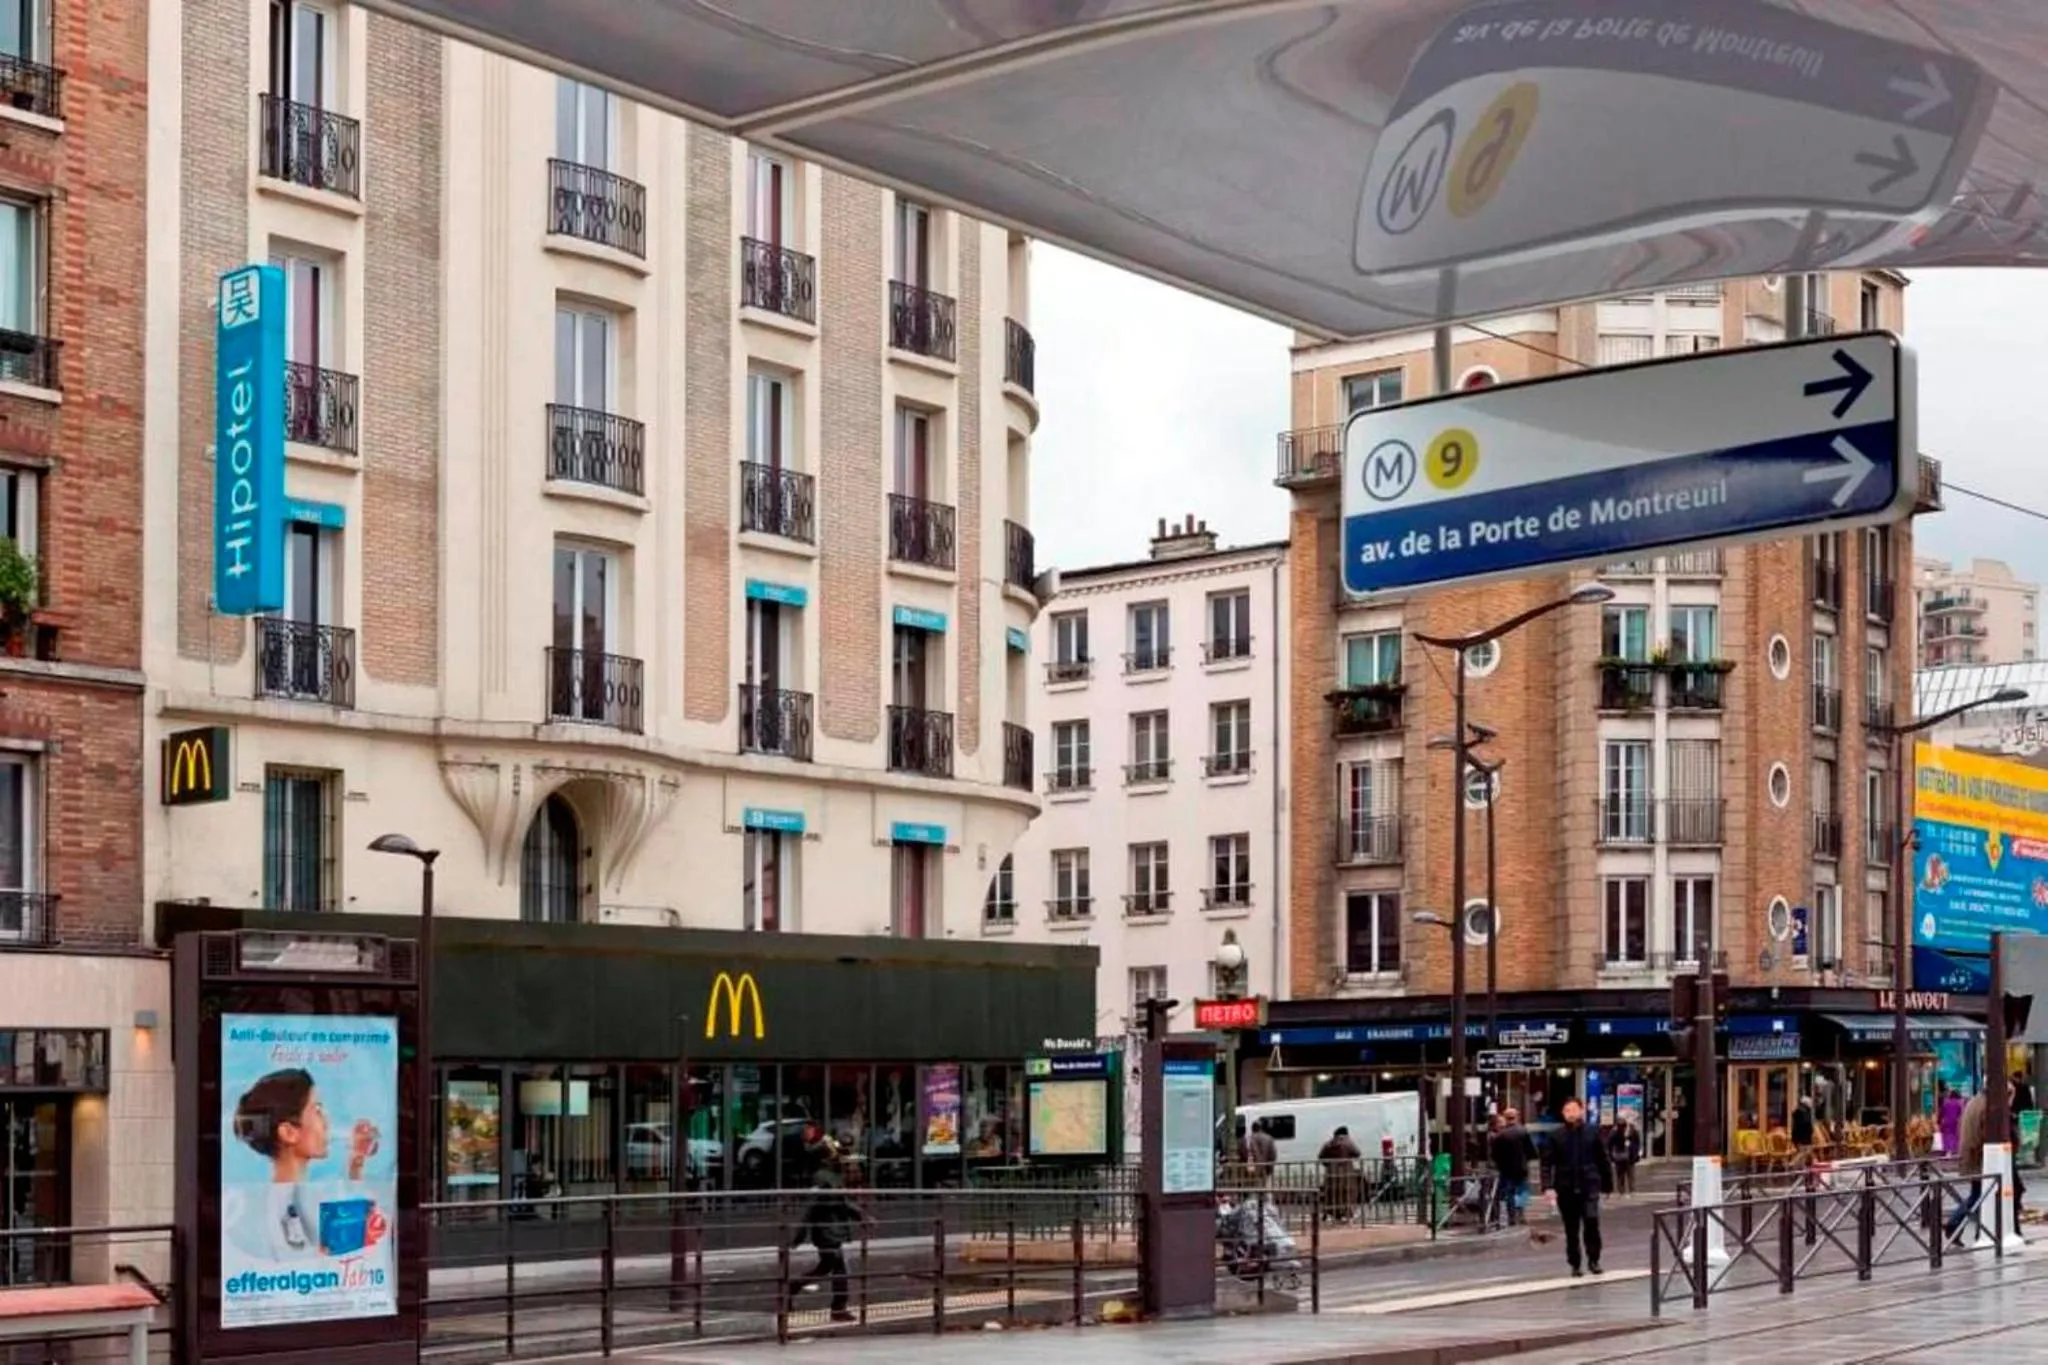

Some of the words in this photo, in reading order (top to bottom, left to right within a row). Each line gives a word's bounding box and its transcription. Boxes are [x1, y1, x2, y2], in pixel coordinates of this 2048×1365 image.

[226, 360, 258, 578] Hipotel
[1440, 441, 1463, 477] 9
[1360, 537, 1394, 563] av.
[1401, 531, 1431, 557] de
[1439, 525, 1461, 550] la
[1469, 515, 1540, 547] Porte
[1548, 506, 1581, 532] de
[1591, 479, 1727, 526] Montreuil
[226, 1270, 339, 1295] efferalgan
